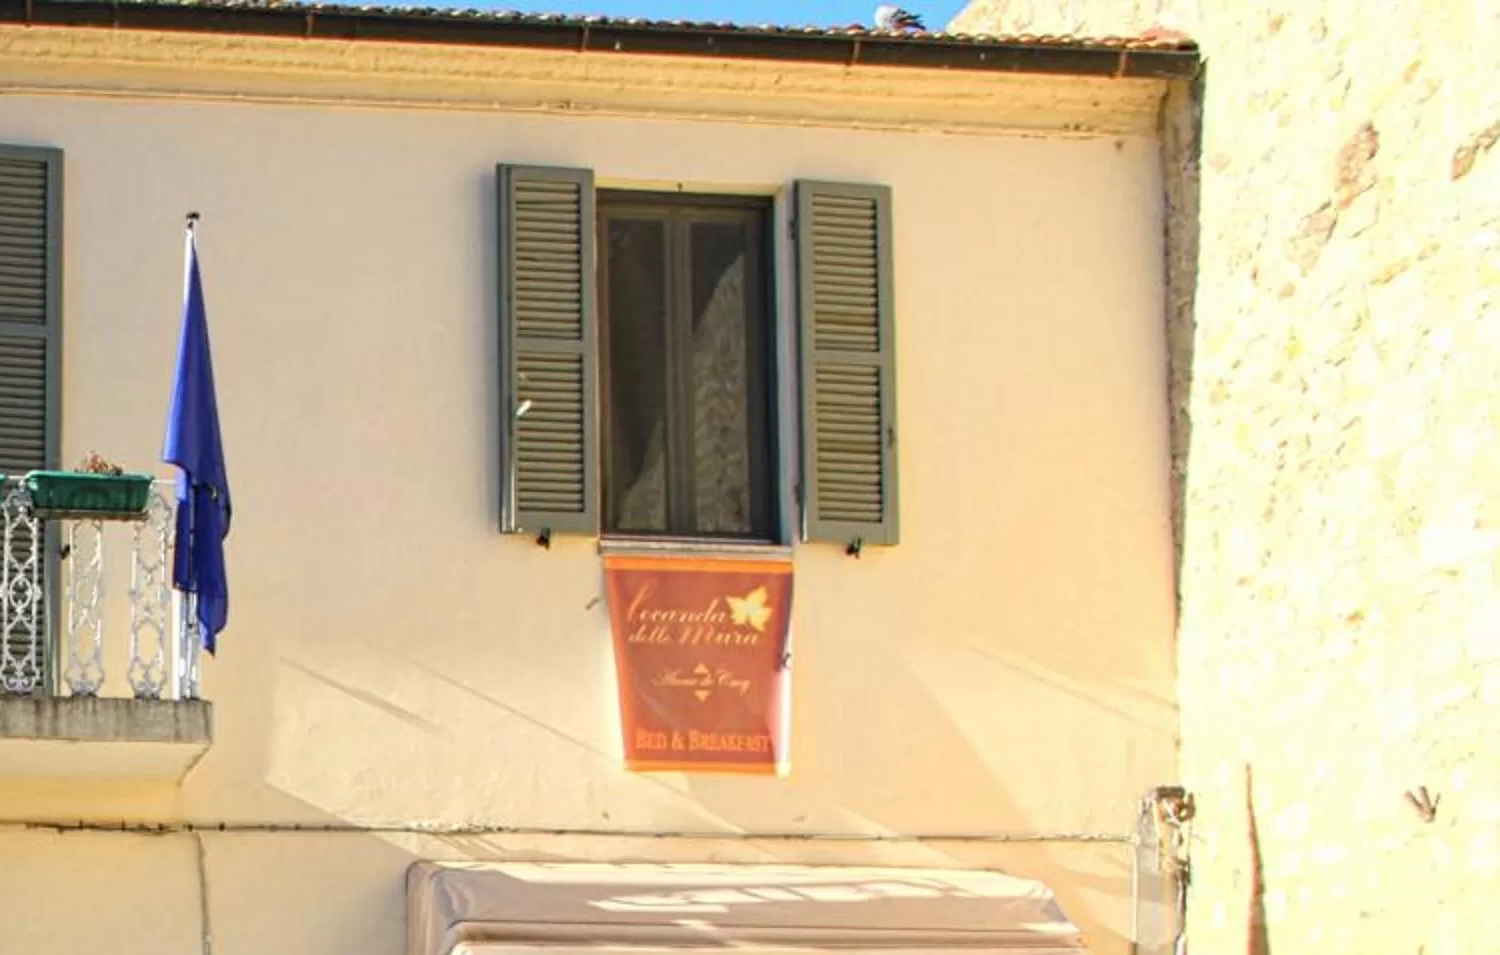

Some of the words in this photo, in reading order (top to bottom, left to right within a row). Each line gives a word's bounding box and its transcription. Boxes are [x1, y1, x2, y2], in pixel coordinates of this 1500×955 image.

[635, 728, 668, 750] BED
[671, 730, 685, 751] &
[688, 729, 769, 752] BREAKFAST
